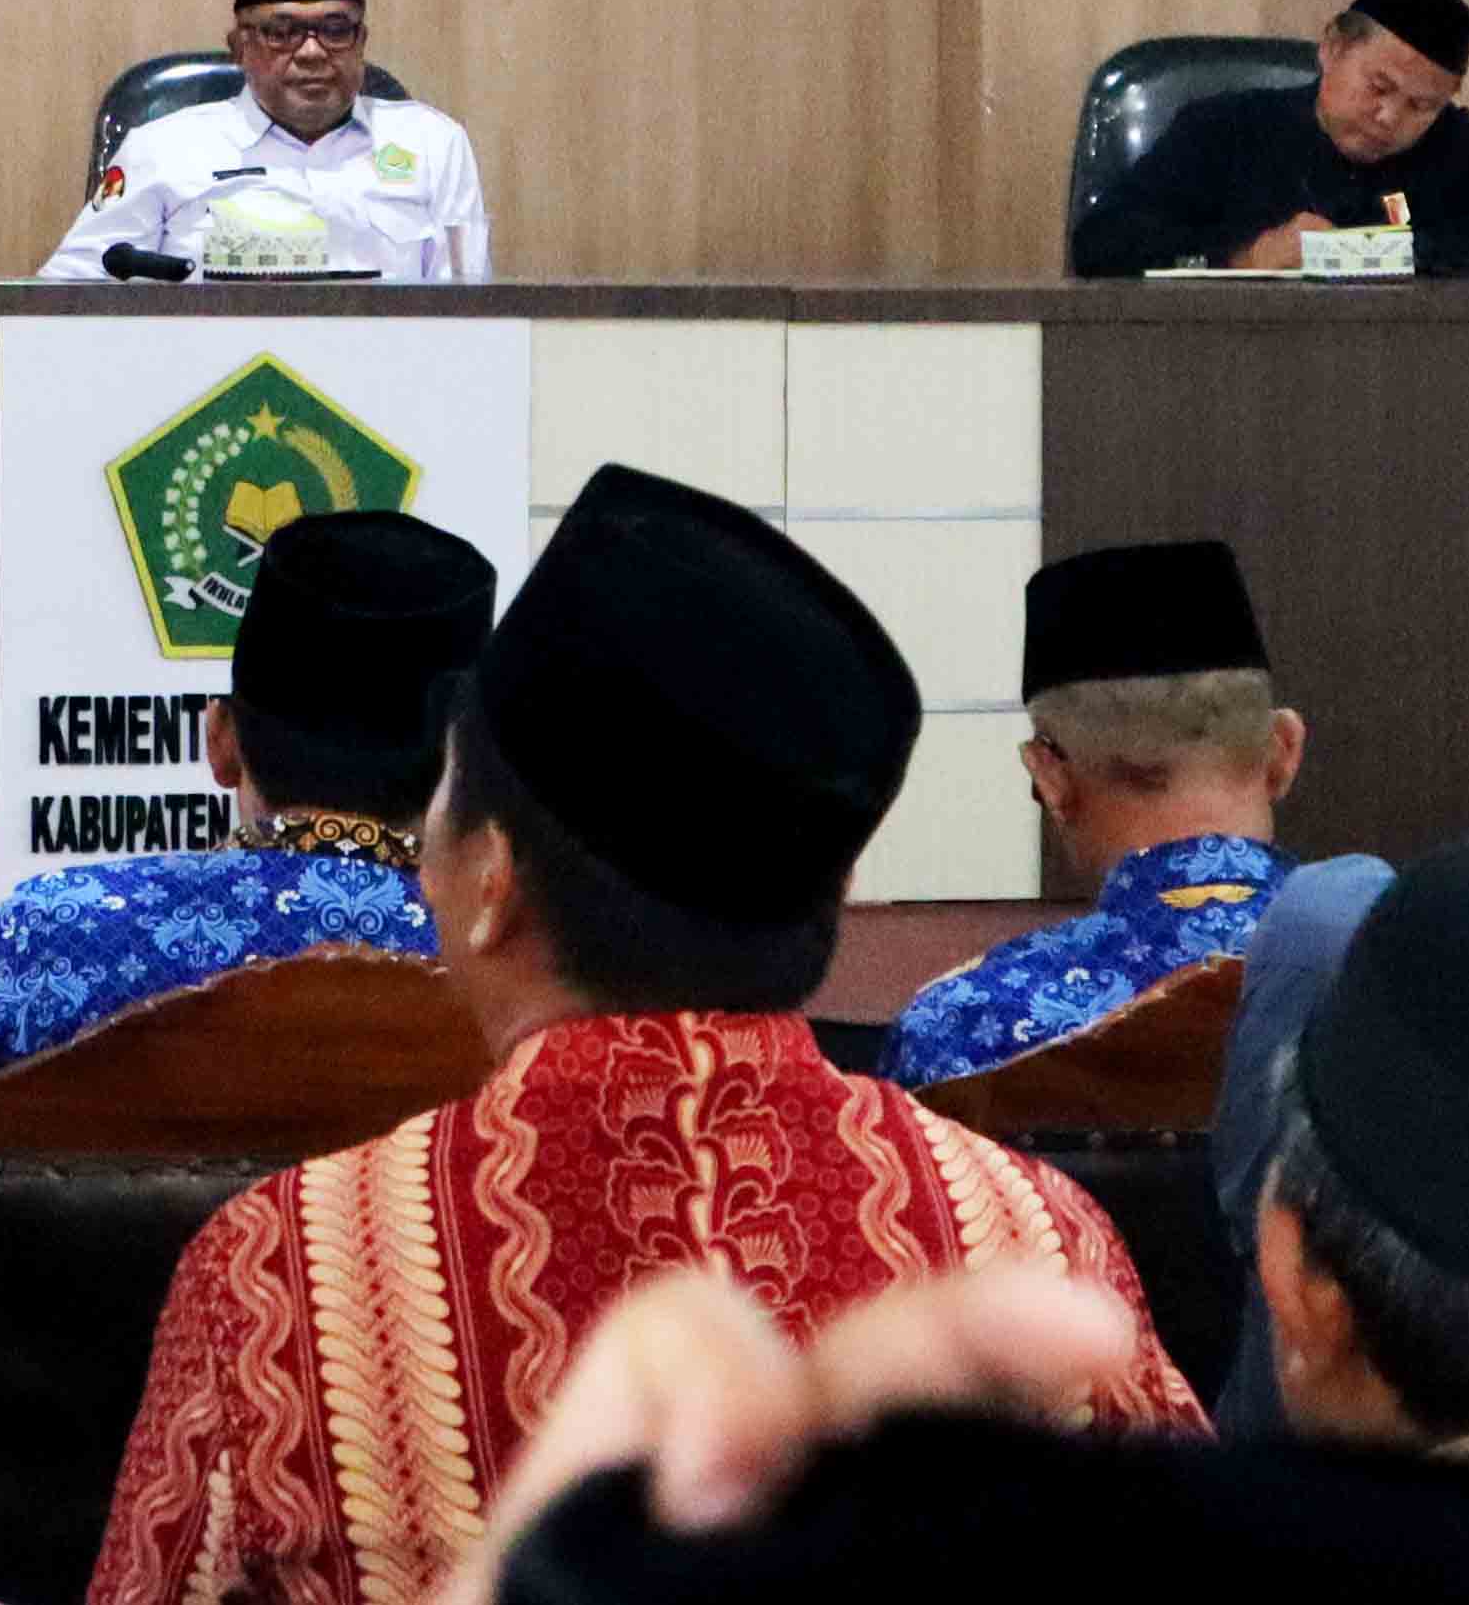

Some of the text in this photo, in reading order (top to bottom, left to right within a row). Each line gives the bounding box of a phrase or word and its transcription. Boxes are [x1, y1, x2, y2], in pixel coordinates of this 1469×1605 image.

[203, 576, 247, 610] IKHLA
[38, 693, 234, 766] KEMENT
[30, 793, 232, 854] KABUPATEN
